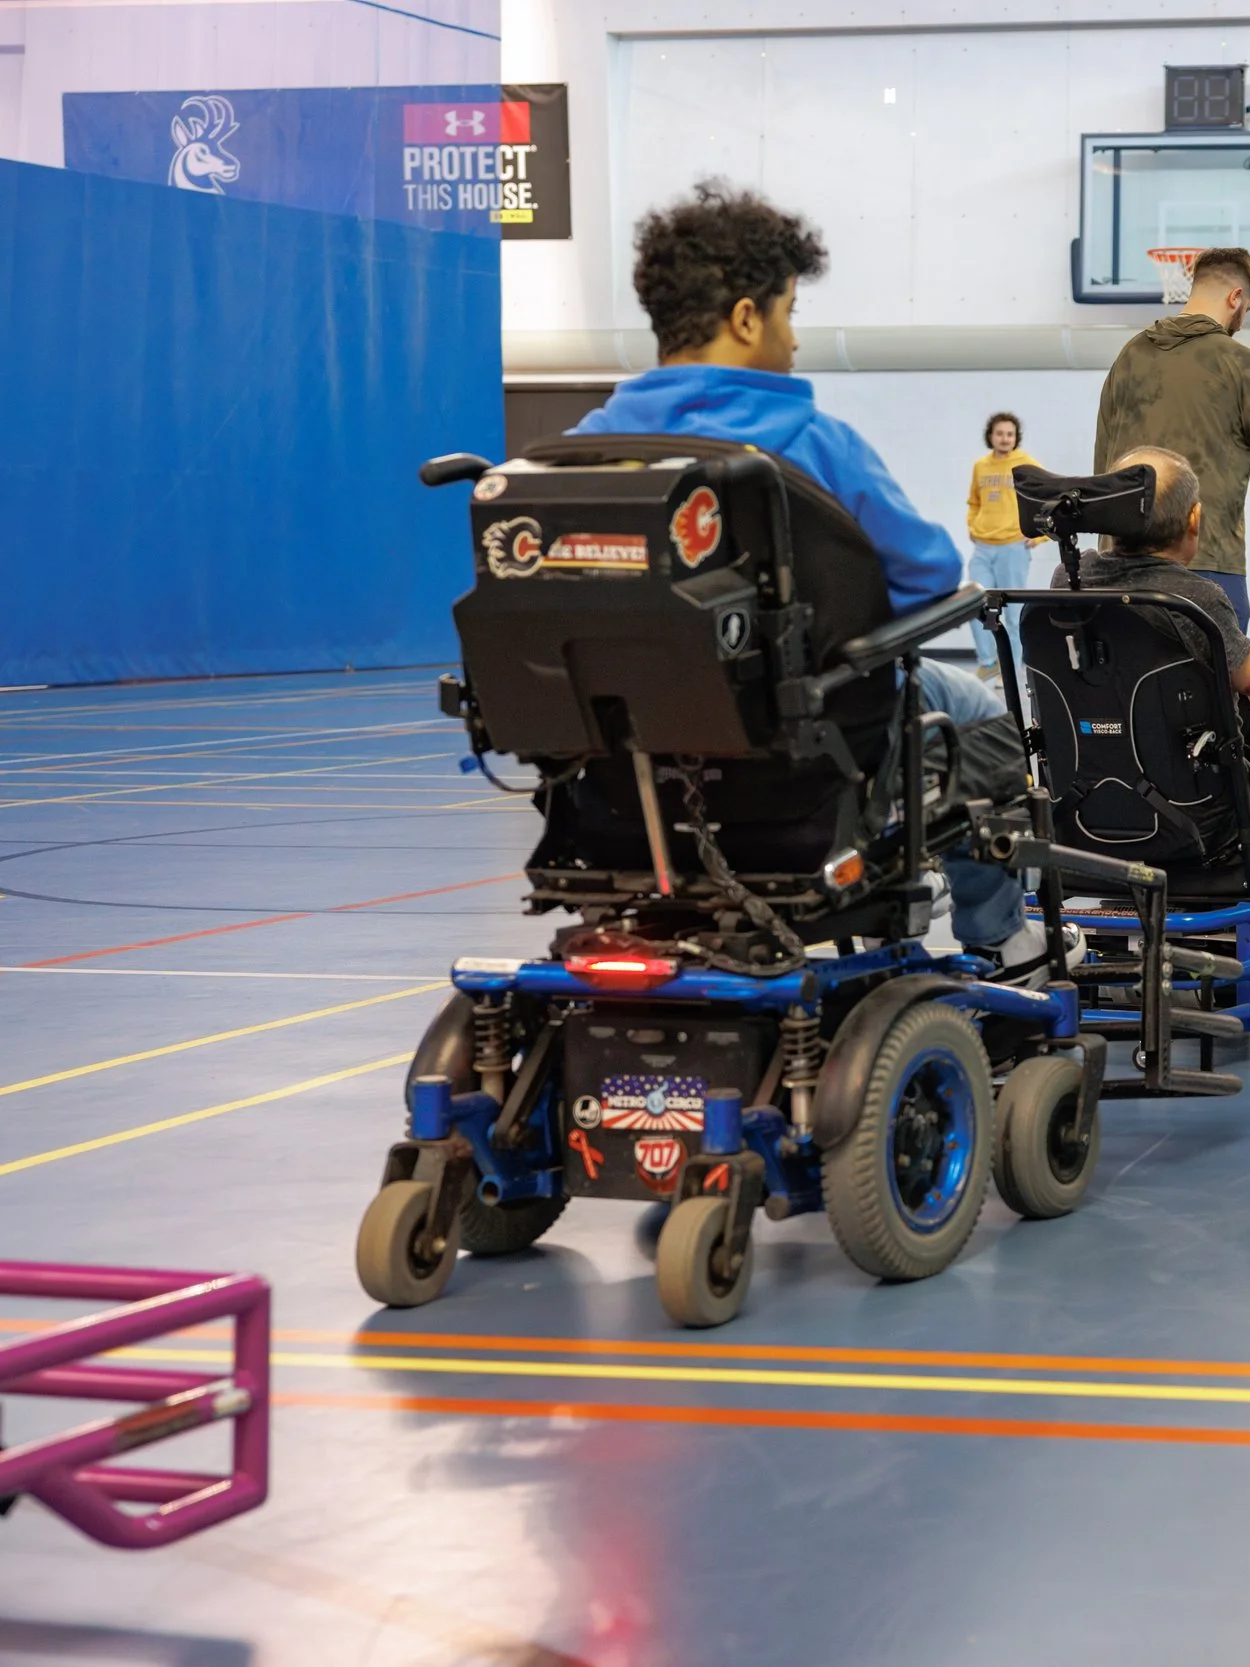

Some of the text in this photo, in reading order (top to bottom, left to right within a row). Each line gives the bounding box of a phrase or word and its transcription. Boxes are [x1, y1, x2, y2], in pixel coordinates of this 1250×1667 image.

[403, 182, 539, 211] THIS HOUSE.
[607, 1095, 647, 1109] NITRO
[639, 1142, 675, 1168] 707
